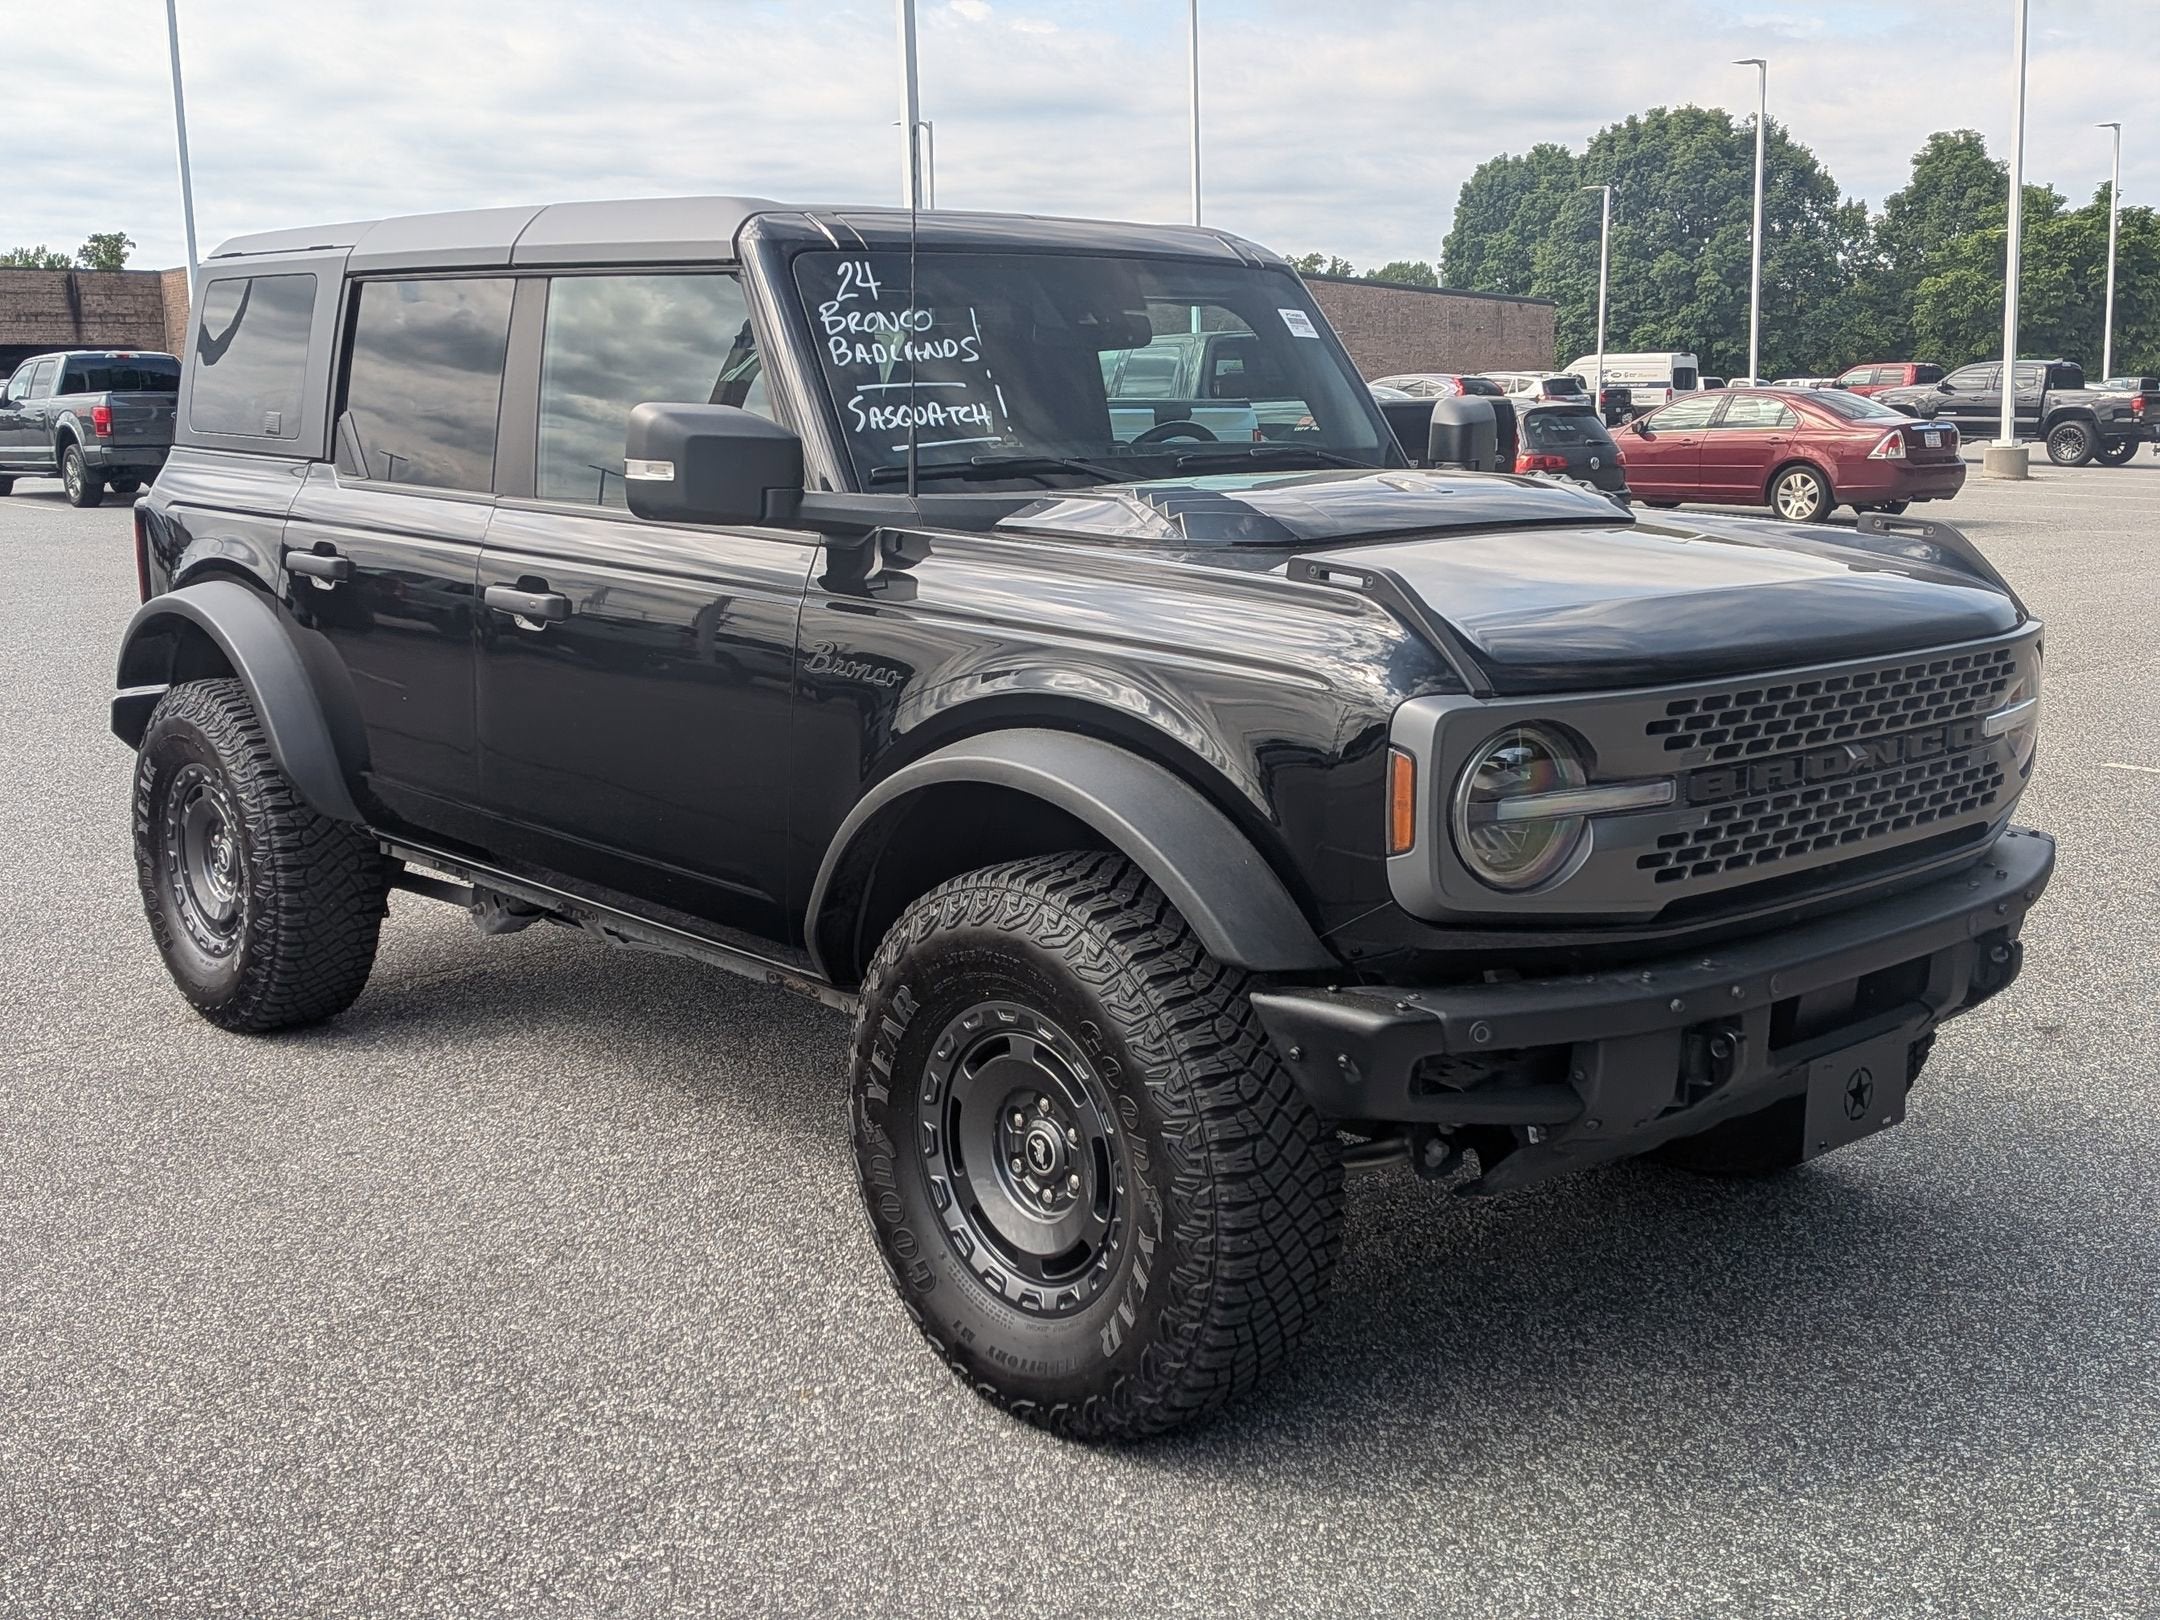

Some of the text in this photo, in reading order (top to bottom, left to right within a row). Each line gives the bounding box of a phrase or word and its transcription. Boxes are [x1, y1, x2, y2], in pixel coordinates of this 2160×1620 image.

[837, 261, 881, 301] 24
[819, 300, 933, 335] BRONCO
[803, 640, 903, 687] Bronco
[1688, 718, 1980, 800] BRONCO
